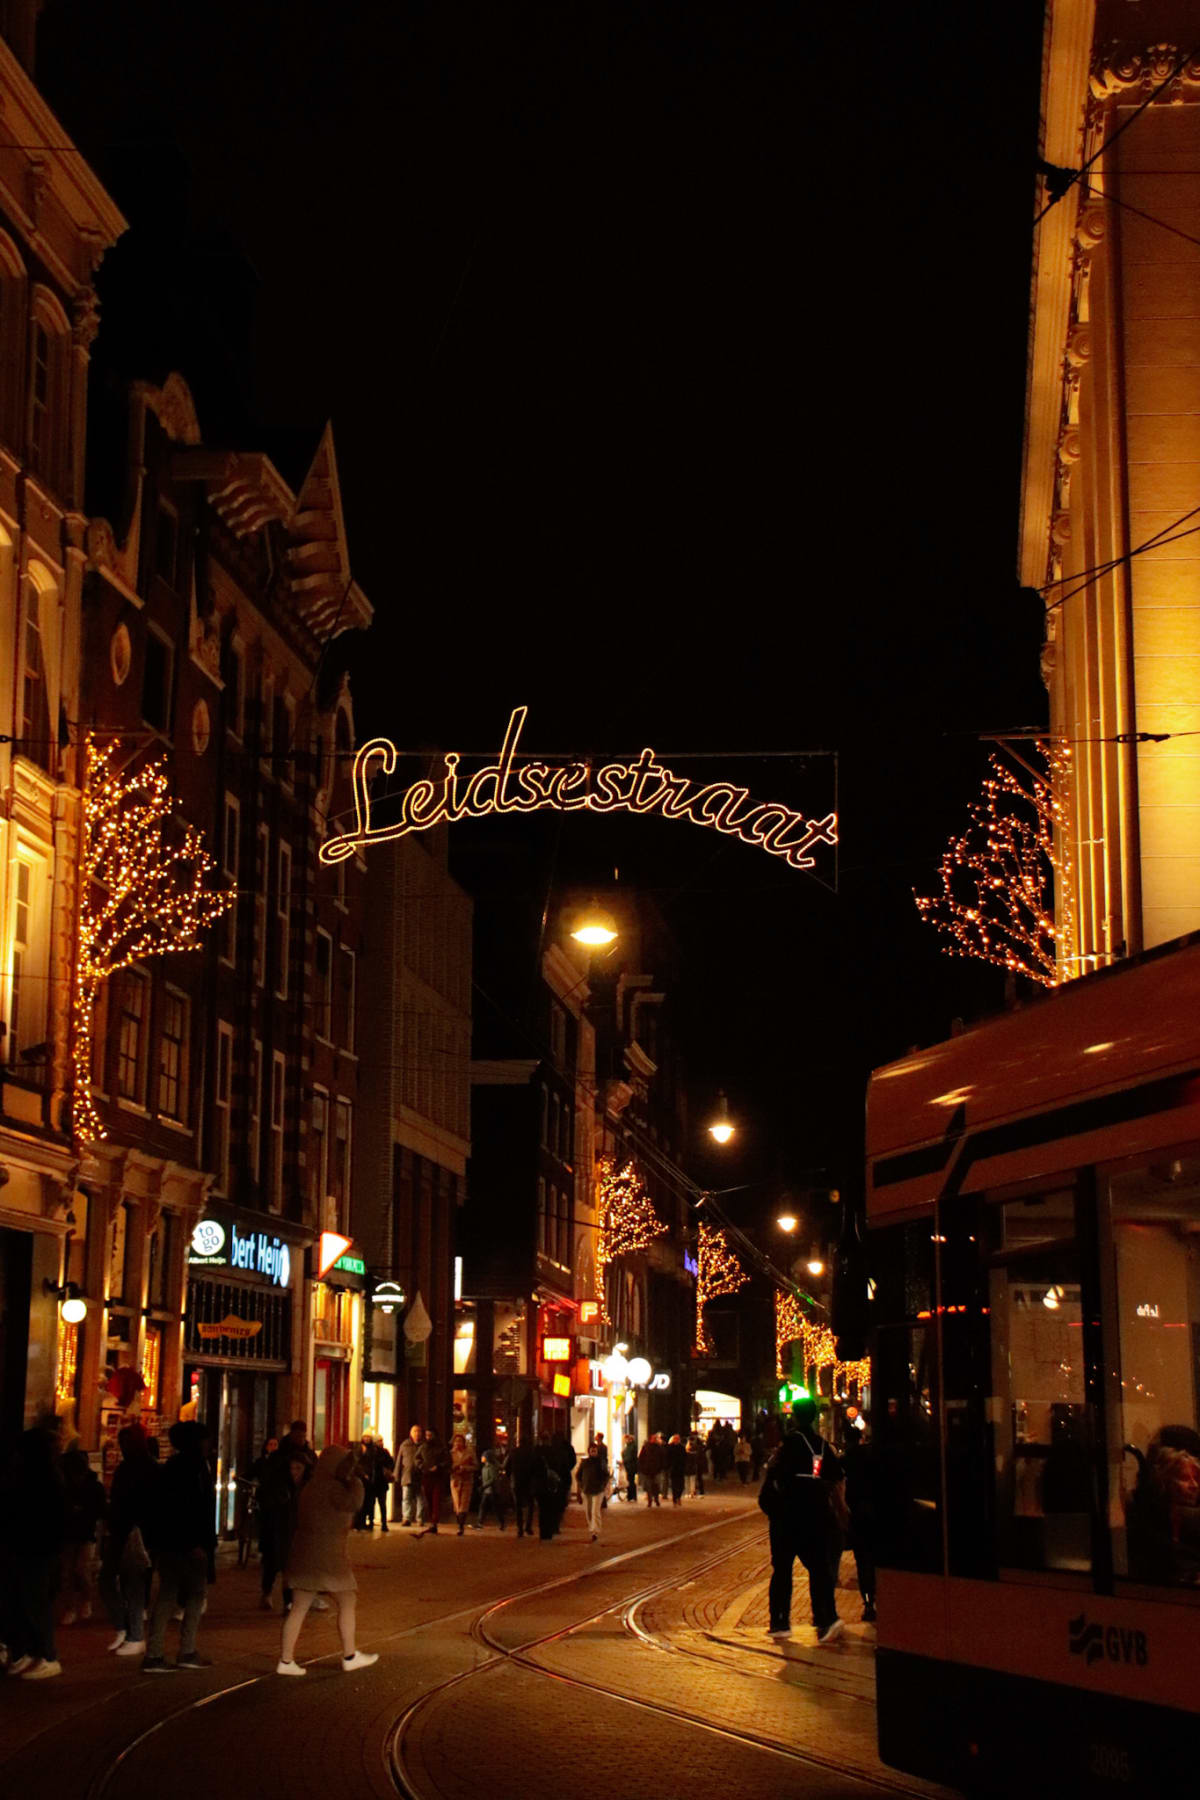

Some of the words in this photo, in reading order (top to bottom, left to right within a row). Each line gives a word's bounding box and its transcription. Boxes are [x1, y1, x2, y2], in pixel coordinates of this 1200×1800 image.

[319, 705, 839, 870] Leidsestraat
[199, 1226, 214, 1239] to
[202, 1235, 220, 1254] go
[231, 1224, 256, 1270] bert
[649, 1373, 671, 1390] JD
[1105, 1625, 1148, 1667] GVB
